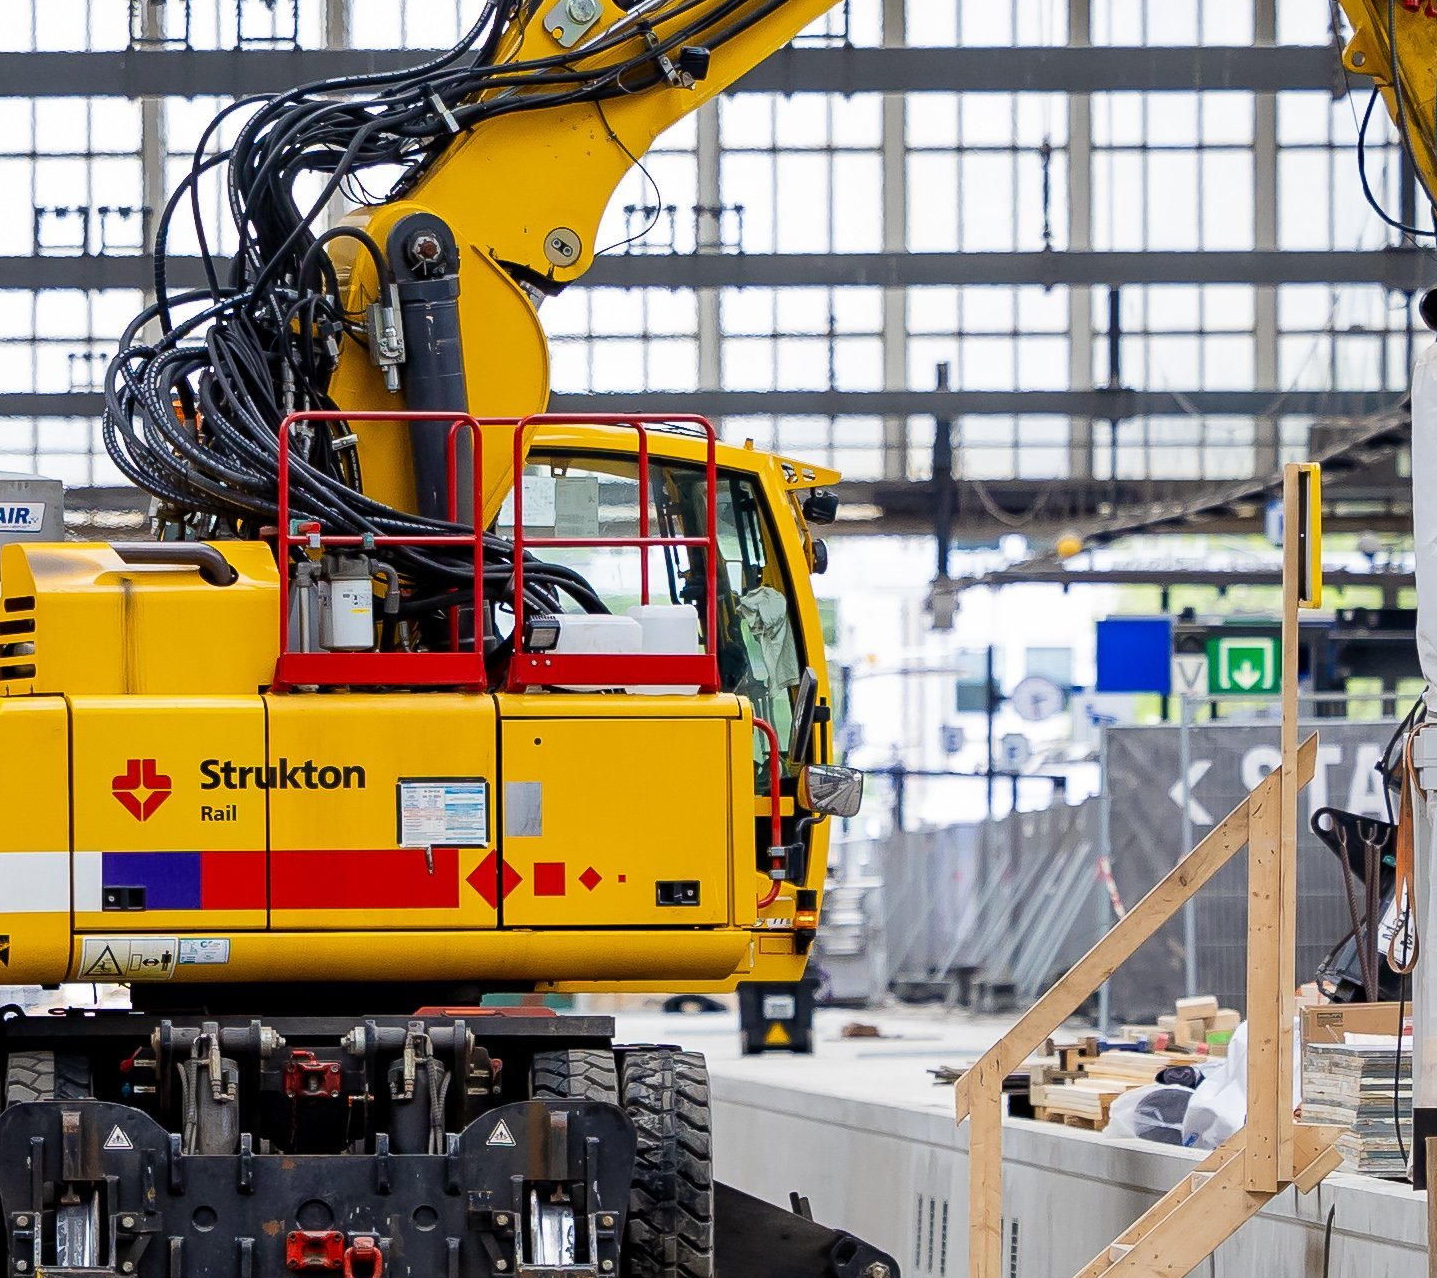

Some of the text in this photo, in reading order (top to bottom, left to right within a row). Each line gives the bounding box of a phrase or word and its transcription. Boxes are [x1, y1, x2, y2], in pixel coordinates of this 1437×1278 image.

[1176, 661, 1206, 694] V
[199, 757, 366, 790] Strukton
[200, 804, 237, 822] Rail
